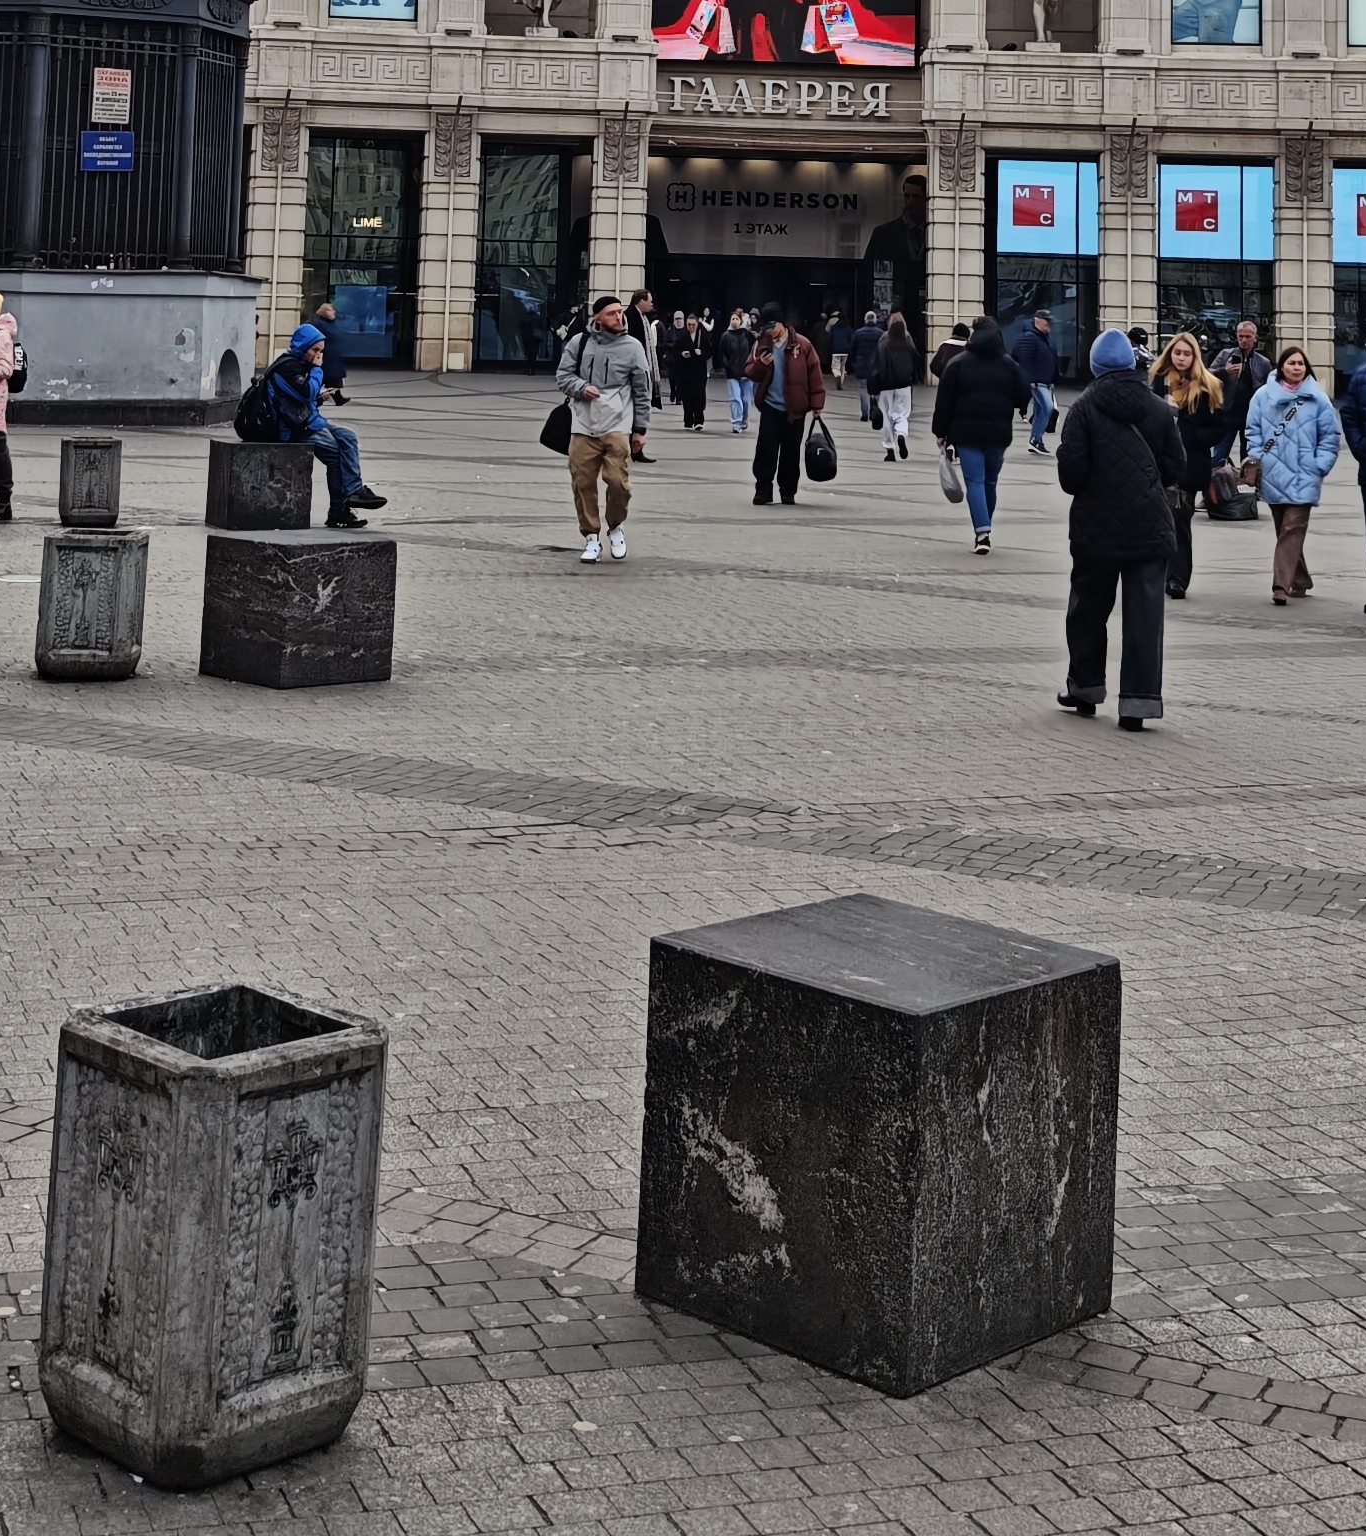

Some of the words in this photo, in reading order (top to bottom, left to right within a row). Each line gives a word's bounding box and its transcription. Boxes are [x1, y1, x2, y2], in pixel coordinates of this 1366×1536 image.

[669, 76, 892, 117] ГАЛЕРЕЯ
[701, 189, 859, 211] HENDERSON
[352, 216, 383, 228] LIME
[733, 222, 742, 234] 1
[745, 223, 789, 236] ЭТАЖ
